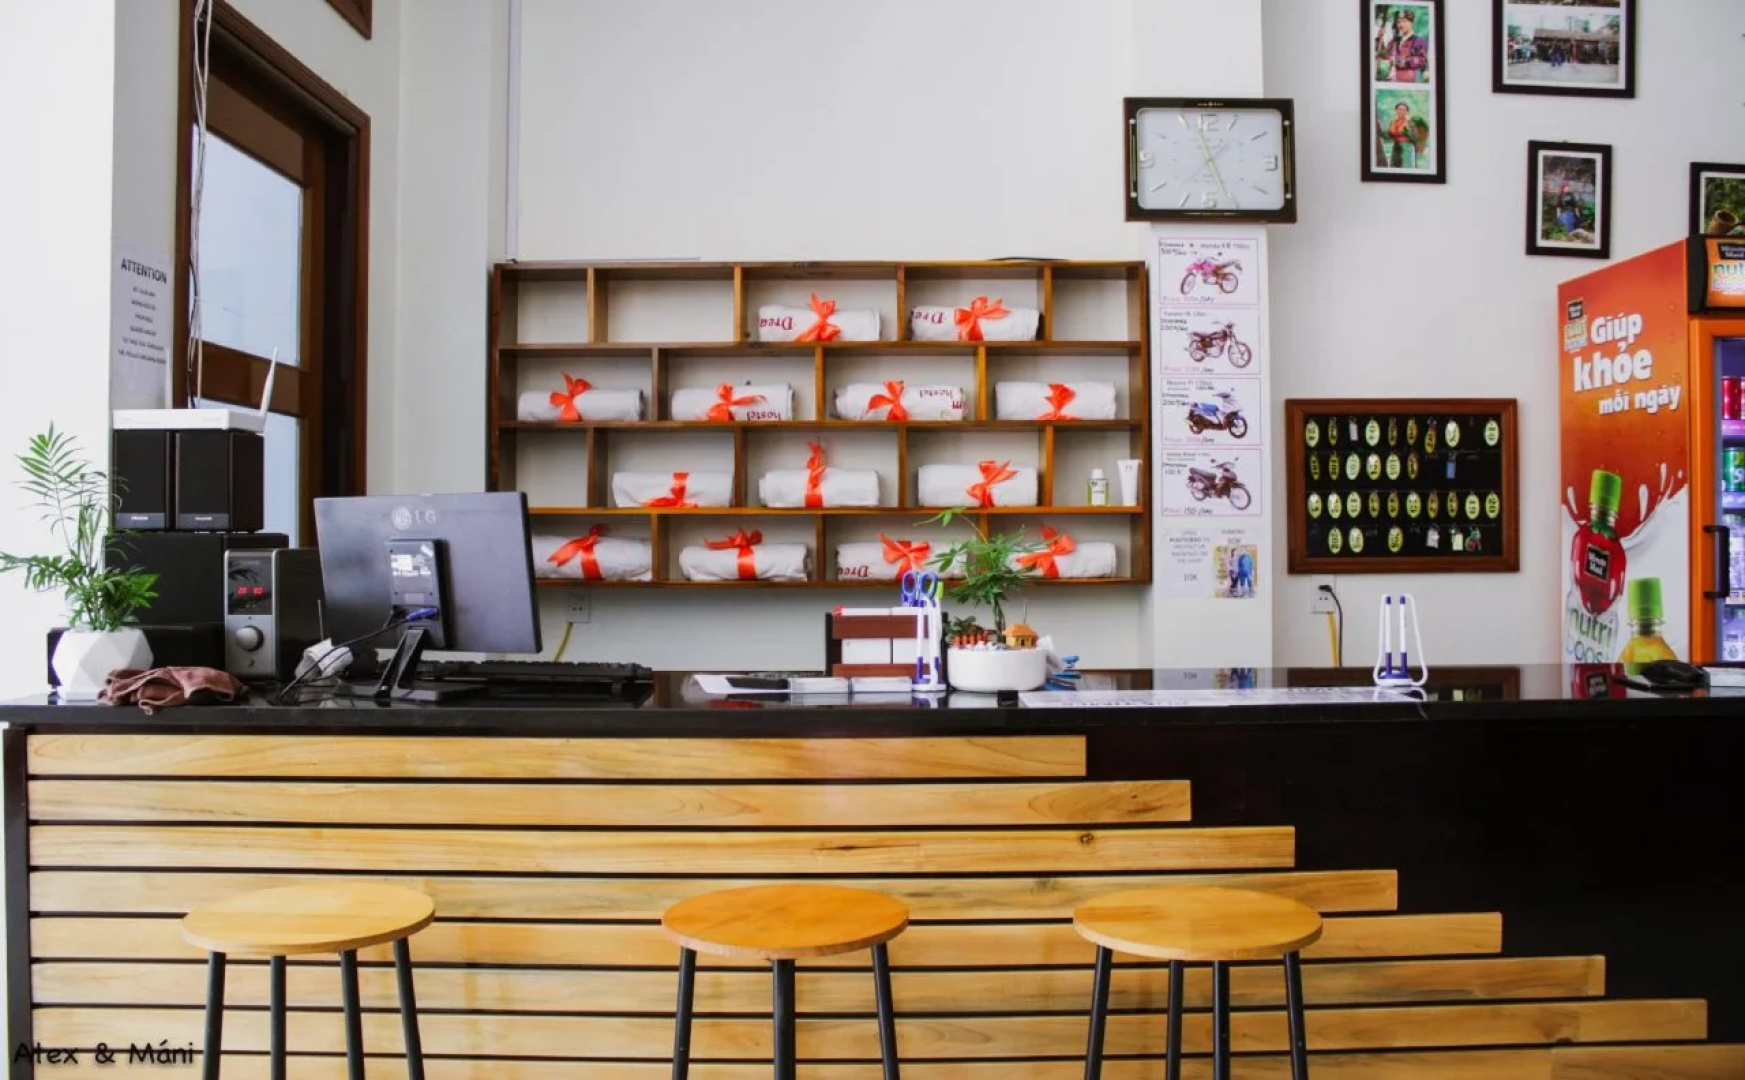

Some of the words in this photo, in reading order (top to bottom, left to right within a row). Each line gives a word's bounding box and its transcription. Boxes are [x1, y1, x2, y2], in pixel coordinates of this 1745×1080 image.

[120, 258, 167, 284] ATTENTION
[1591, 312, 1643, 345] Giúp
[1573, 341, 1652, 393] khỏe
[919, 389, 953, 399] hostel
[746, 411, 782, 421] hostel
[414, 509, 437, 524] LG
[1570, 607, 1612, 648] nutri
